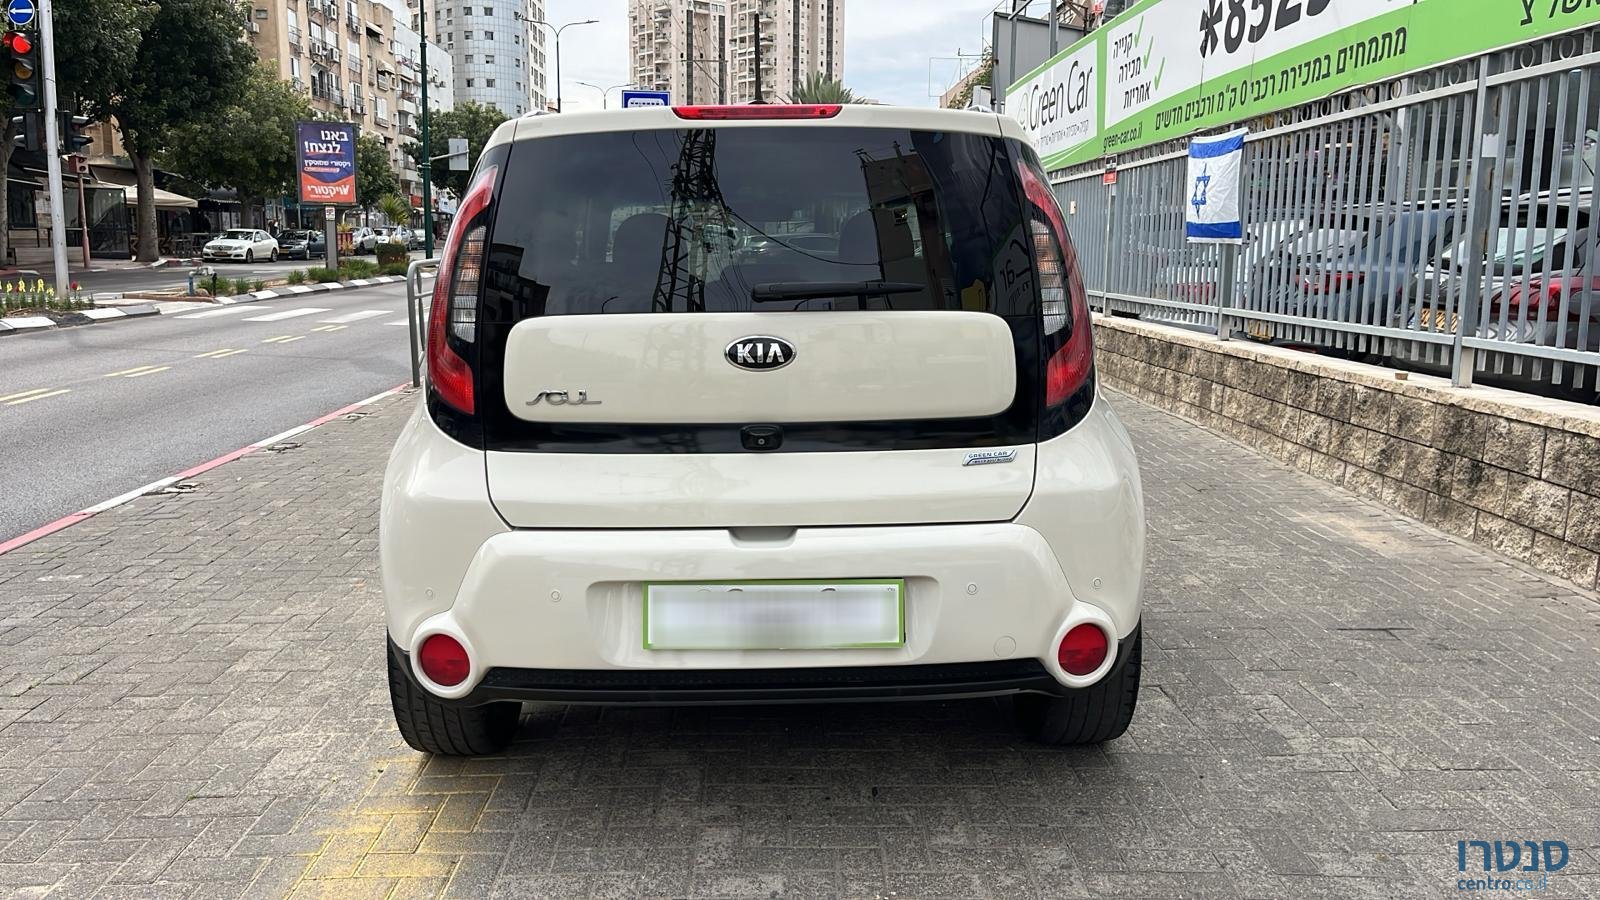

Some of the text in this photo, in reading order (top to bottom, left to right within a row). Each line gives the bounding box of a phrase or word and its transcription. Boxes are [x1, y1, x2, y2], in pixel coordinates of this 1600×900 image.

[1113, 33, 1133, 59] קנייה
[1336, 26, 1407, 74] מתמחים
[1118, 57, 1141, 83] מכירה
[1278, 54, 1331, 94] במכירת
[1030, 60, 1093, 131] Green Car
[1123, 81, 1151, 110] אחריות
[1240, 79, 1247, 106] 0
[1250, 74, 1276, 102] רכבי
[1155, 106, 1183, 130] חדשים
[1185, 95, 1215, 121] ורכבים
[304, 141, 340, 153] לנצח!
[321, 130, 348, 141] באנו
[1103, 121, 1143, 152] green-car.co.il
[736, 343, 785, 363] KIA
[526, 390, 602, 405] SOUL
